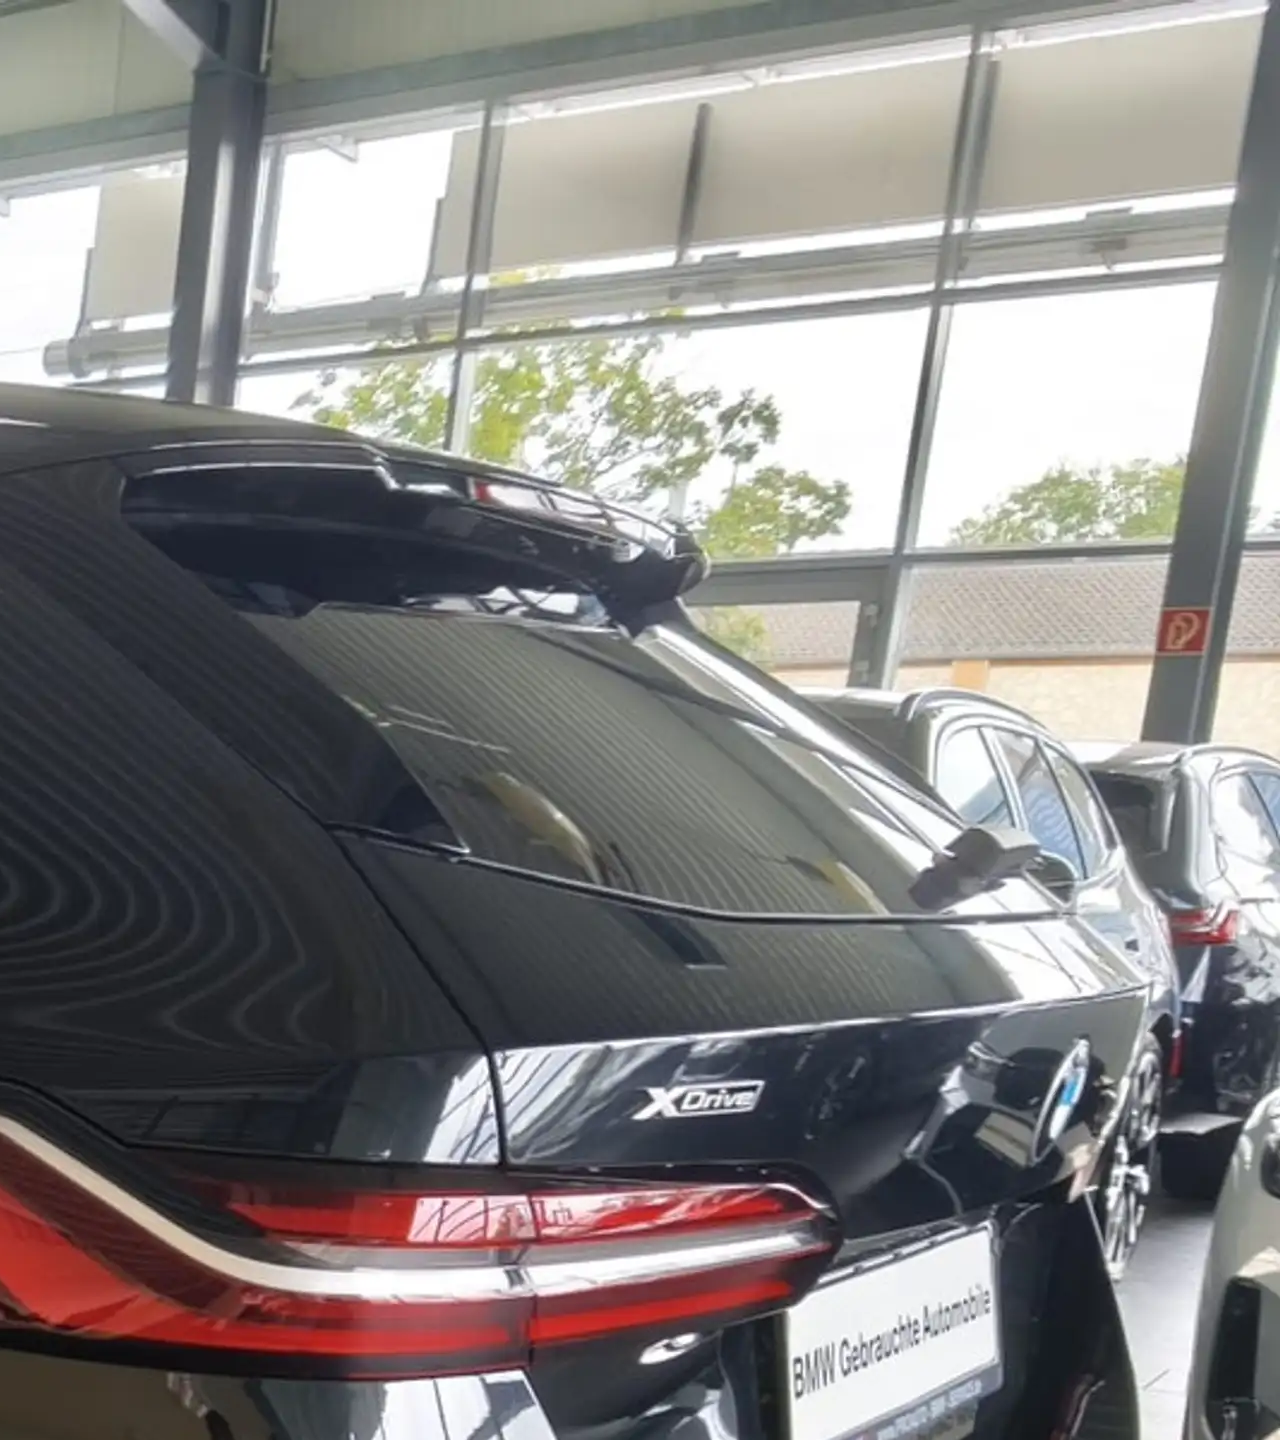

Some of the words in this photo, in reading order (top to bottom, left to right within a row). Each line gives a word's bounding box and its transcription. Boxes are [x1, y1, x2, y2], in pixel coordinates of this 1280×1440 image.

[793, 1342, 836, 1400] BMW
[840, 1314, 920, 1378] Gebrauchte
[922, 1284, 990, 1341] Automobile
